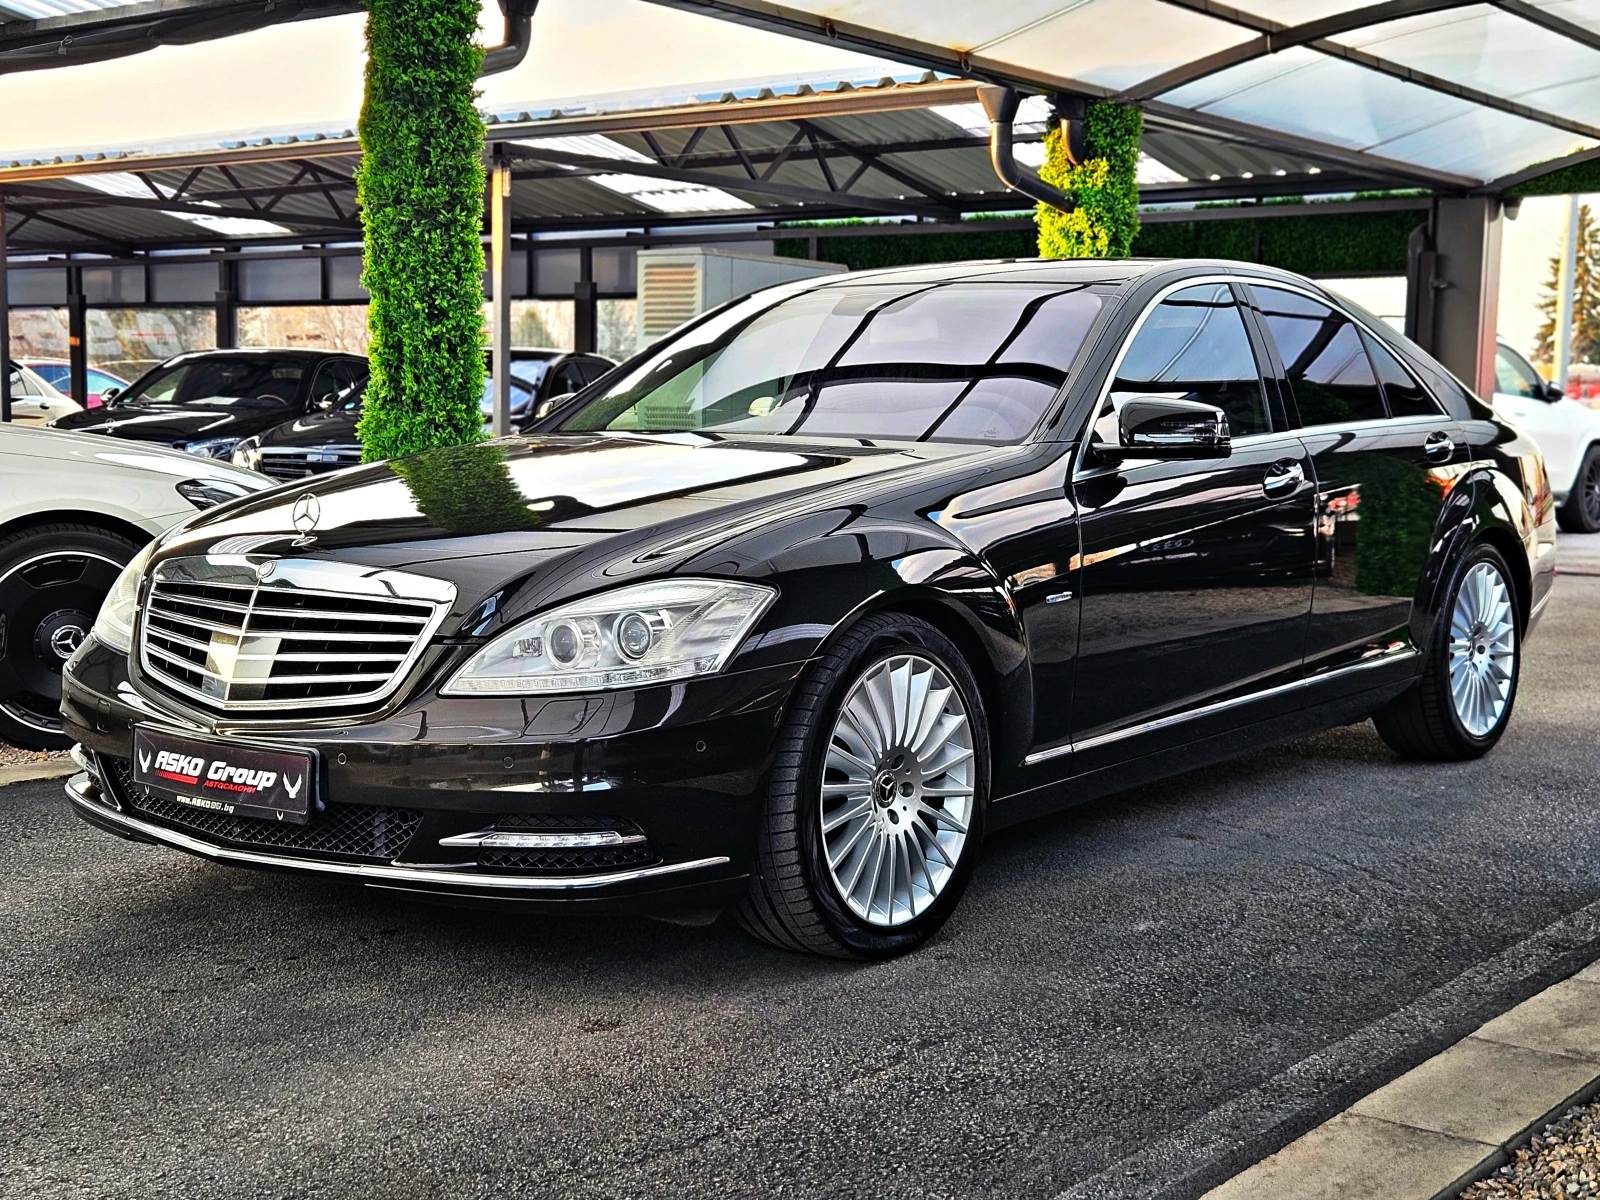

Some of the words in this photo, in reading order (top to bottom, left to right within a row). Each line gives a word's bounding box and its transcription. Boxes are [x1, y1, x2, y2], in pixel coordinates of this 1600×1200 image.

[154, 751, 204, 776] ASKO
[207, 761, 277, 790] Group
[203, 780, 256, 793] АВТОСАЛОНИ
